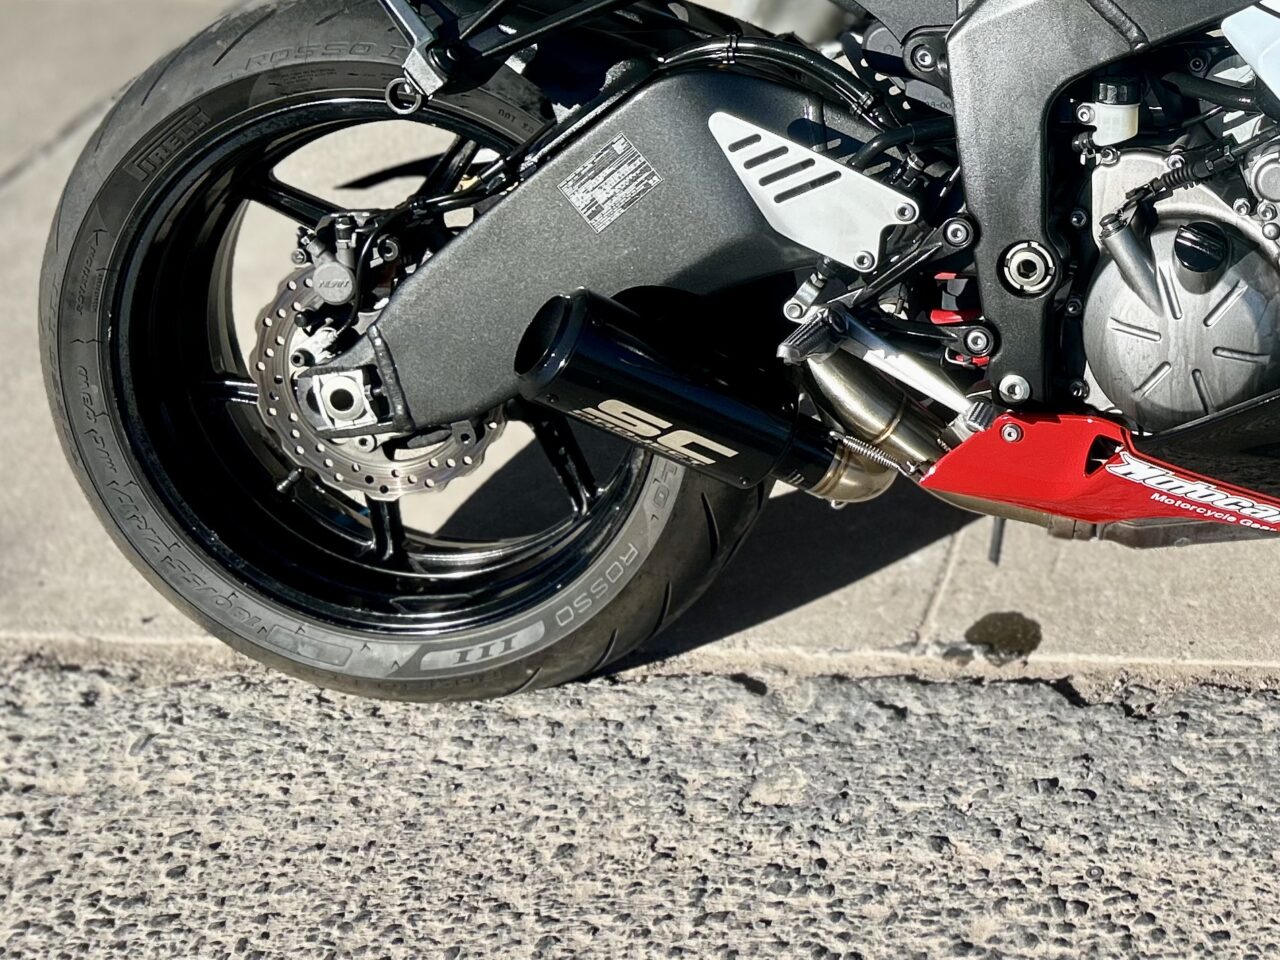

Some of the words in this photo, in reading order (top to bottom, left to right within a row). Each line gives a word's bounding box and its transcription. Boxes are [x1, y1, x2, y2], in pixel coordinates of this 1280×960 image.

[580, 399, 740, 465] SC
[1150, 493, 1236, 522] Motorcycle
[555, 543, 638, 628] ROSSO
